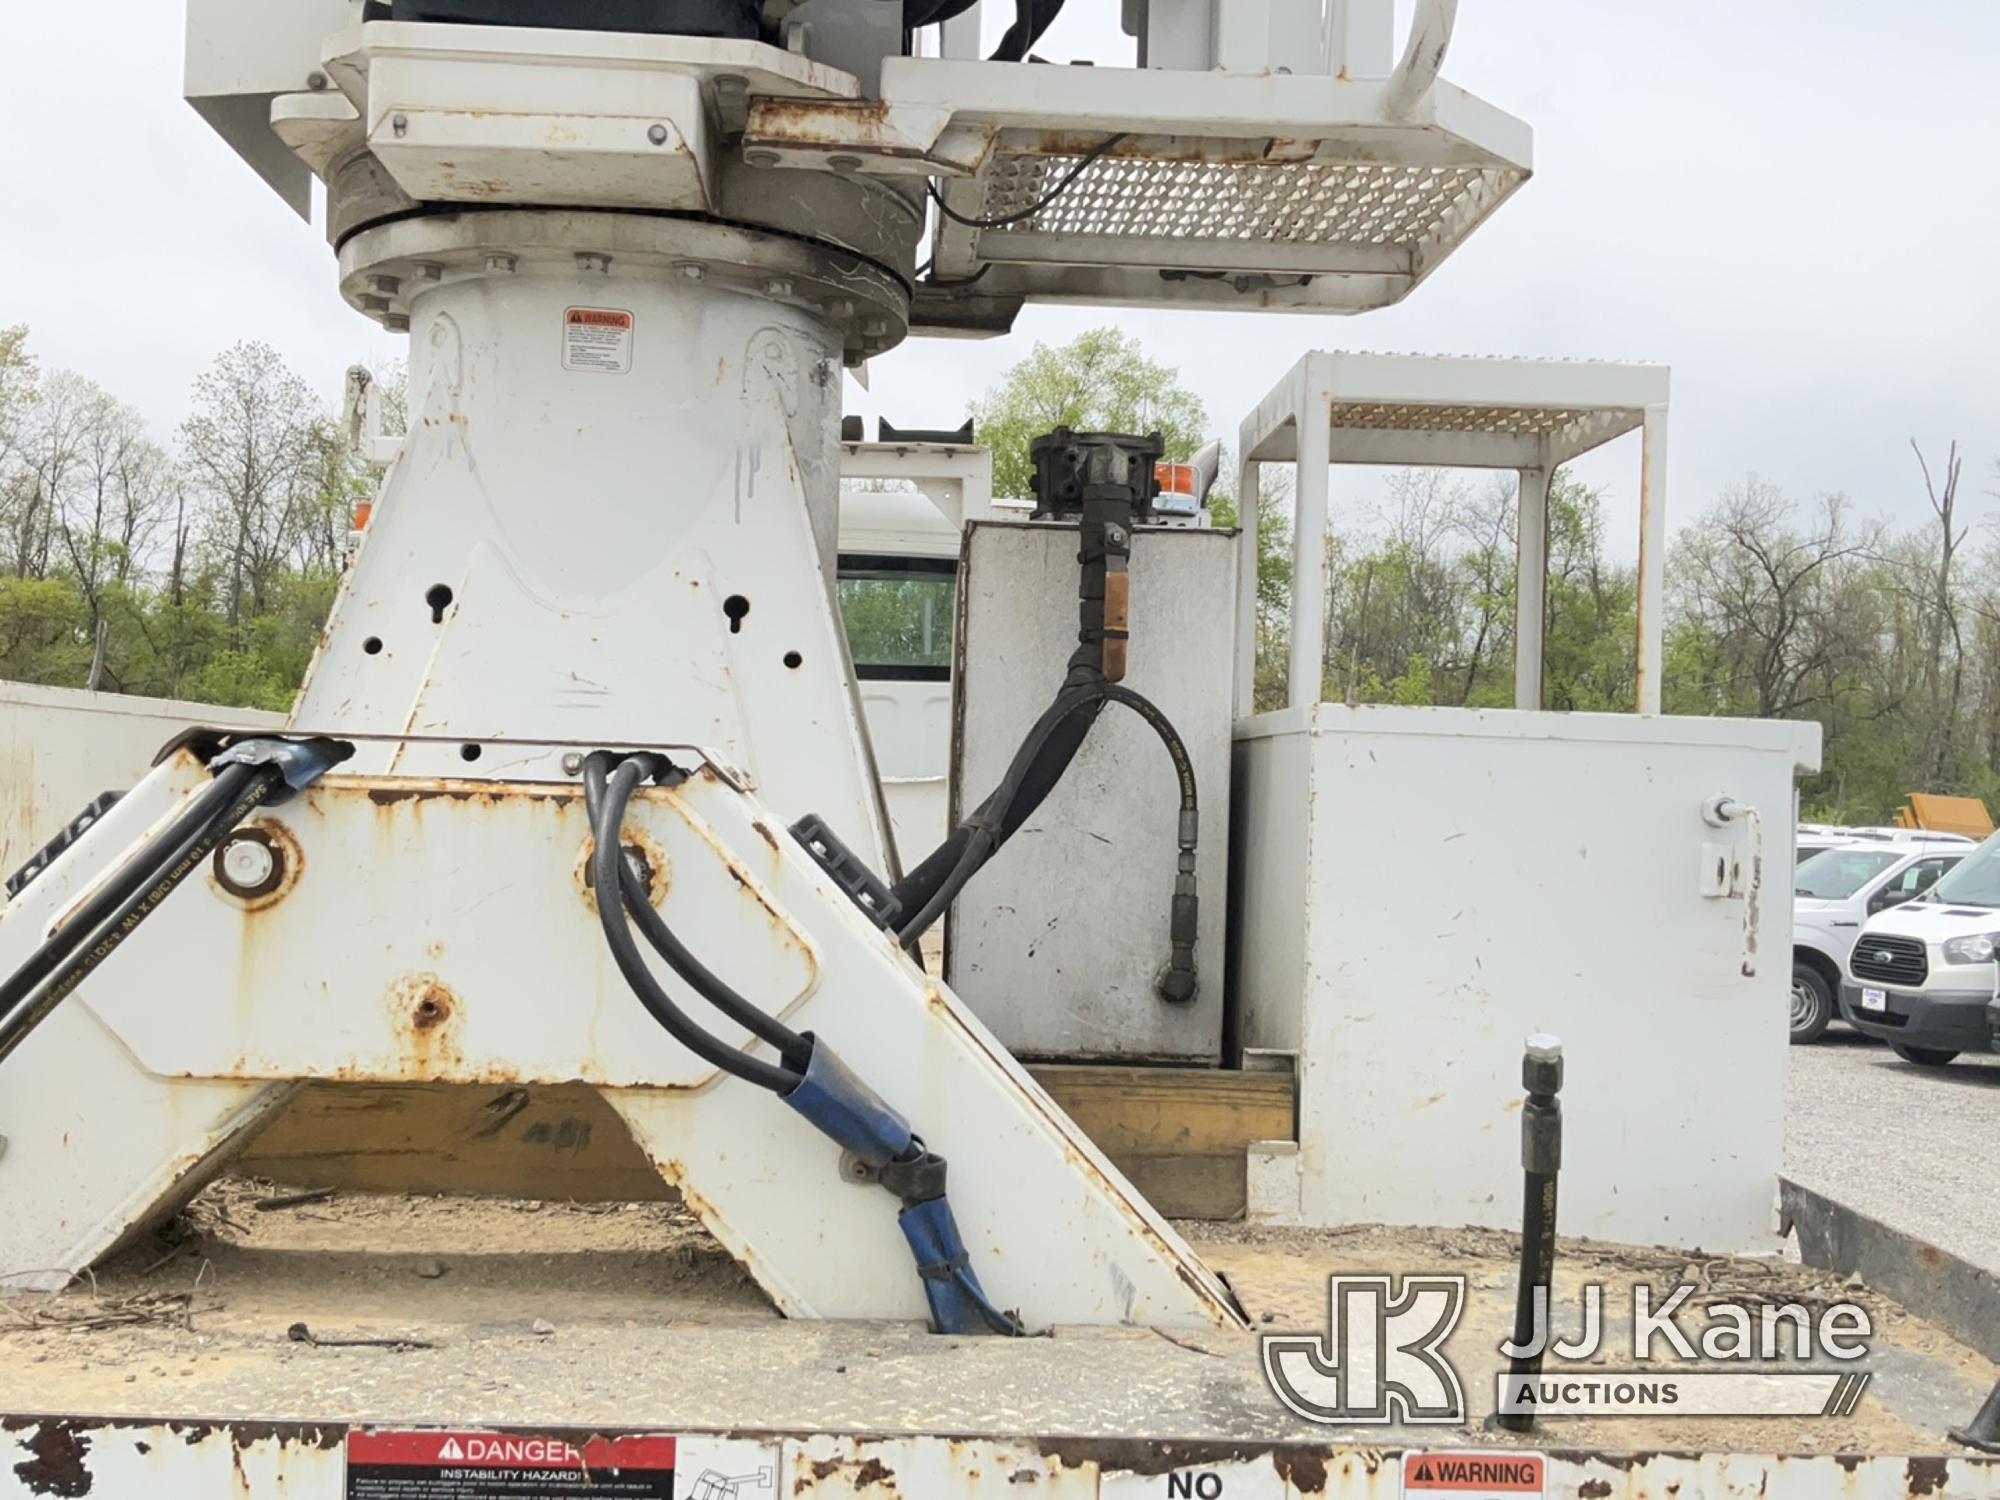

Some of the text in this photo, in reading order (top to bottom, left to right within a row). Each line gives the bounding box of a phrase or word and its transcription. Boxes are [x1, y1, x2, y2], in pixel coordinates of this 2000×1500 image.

[440, 1469, 582, 1481] INSTABILITY HAZARD!
[1436, 1462, 1535, 1484] WARNING
[1167, 1471, 1223, 1500] NO
